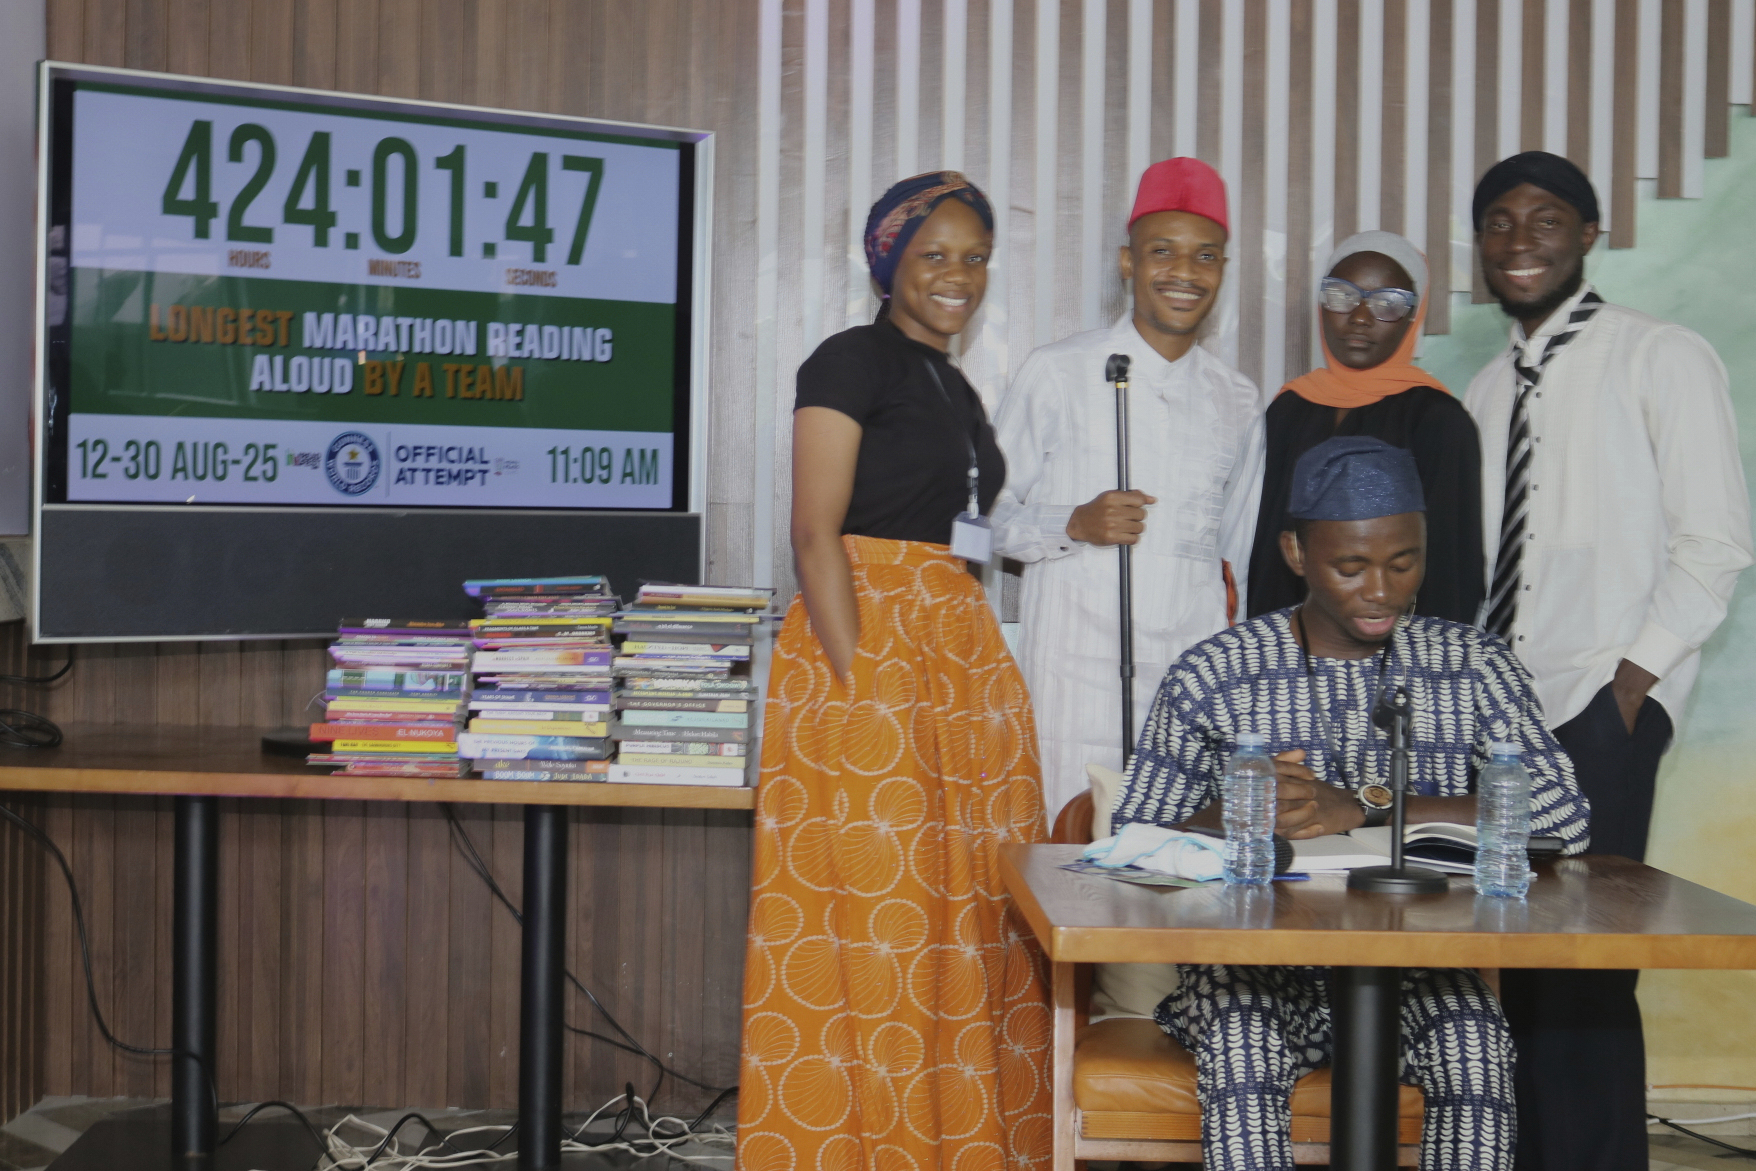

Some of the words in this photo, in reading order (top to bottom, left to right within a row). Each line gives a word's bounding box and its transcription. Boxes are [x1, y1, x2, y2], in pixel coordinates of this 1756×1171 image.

[161, 119, 606, 267] 424:01:47
[228, 249, 271, 269] HOURS
[368, 258, 421, 279] MINUTES
[505, 268, 557, 288] SECONDS
[149, 304, 294, 347] LONGEST
[303, 311, 478, 356] MARATHON
[486, 321, 613, 362] READING
[250, 354, 354, 395] ALOUD
[363, 359, 405, 396] BY
[412, 361, 434, 398] A
[442, 363, 525, 401] TEAM
[76, 438, 162, 481] 12-30
[170, 441, 278, 482] AUG-25
[395, 445, 490, 465] OFFICIAL
[547, 445, 613, 485] 11:09
[620, 447, 660, 486] AM
[393, 467, 490, 487] ATTEMPT
[319, 725, 345, 734] NINE
[350, 726, 380, 736] LIVES
[397, 728, 409, 736] EL
[410, 729, 445, 737] NUKOYA
[495, 770, 515, 779] BOOM
[516, 771, 535, 779] BOOM
[553, 772, 568, 780] JUDE
